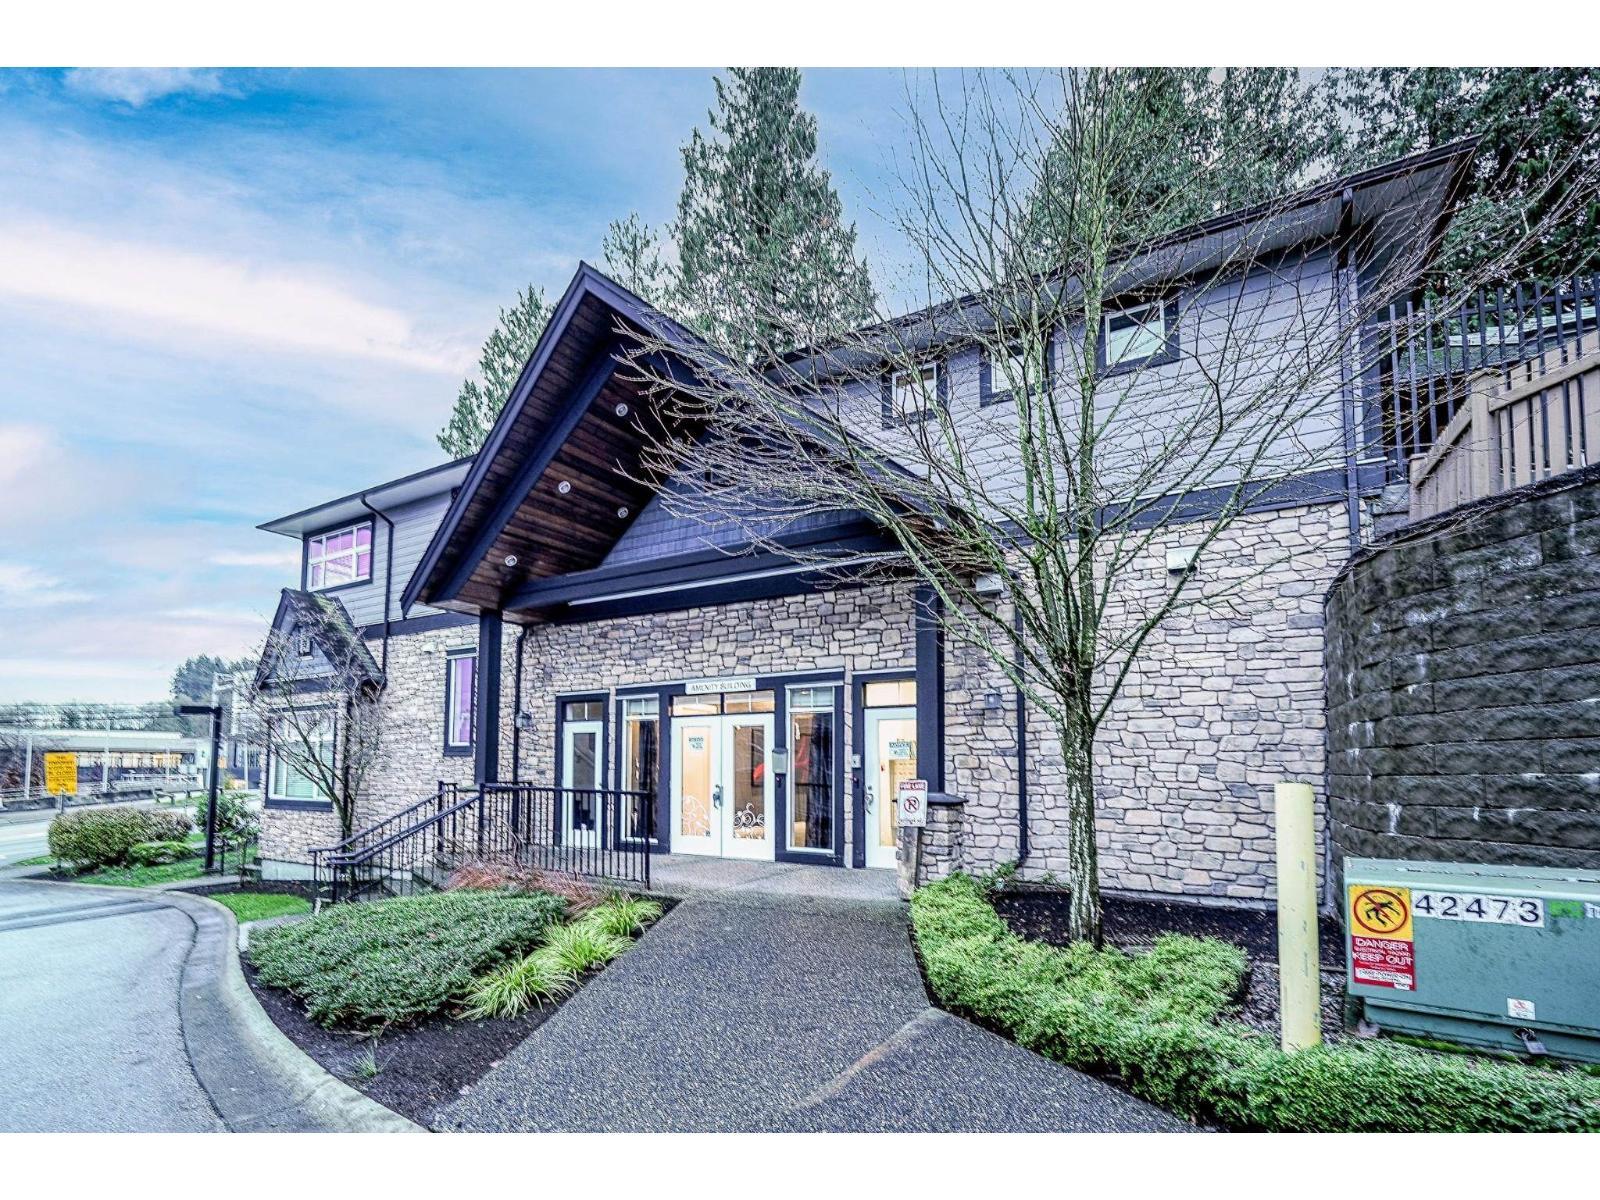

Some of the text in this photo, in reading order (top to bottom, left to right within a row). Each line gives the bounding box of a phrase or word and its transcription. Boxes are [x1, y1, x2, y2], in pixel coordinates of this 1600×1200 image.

[691, 681, 752, 692] AMENITY BUILDING
[1415, 895, 1540, 922] 42473
[1355, 937, 1409, 951] DANGER
[1352, 951, 1385, 962] KEEP
[1385, 954, 1414, 966] OUT
